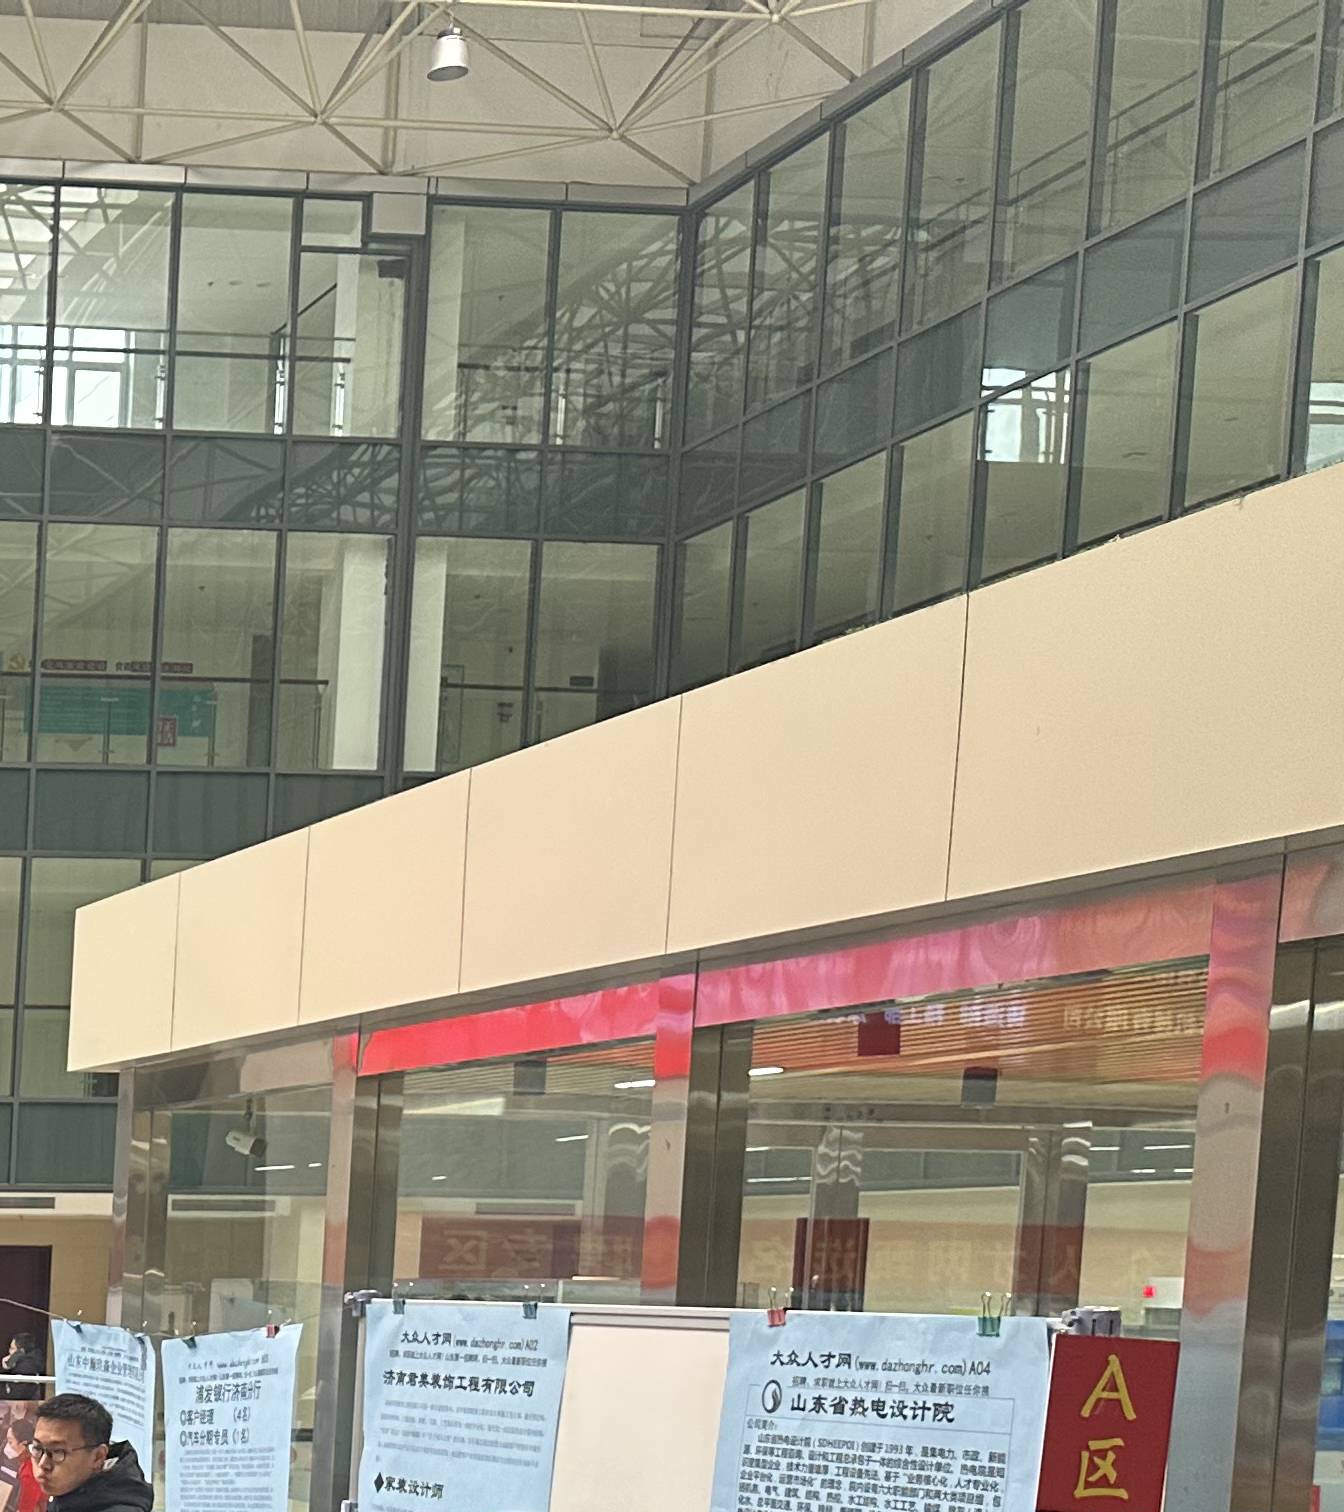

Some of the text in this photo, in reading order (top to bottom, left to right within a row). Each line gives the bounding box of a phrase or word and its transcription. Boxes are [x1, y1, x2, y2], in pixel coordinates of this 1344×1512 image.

[790, 1393, 955, 1423] 山东省热电设计院
[1073, 1354, 1136, 1500] A区
